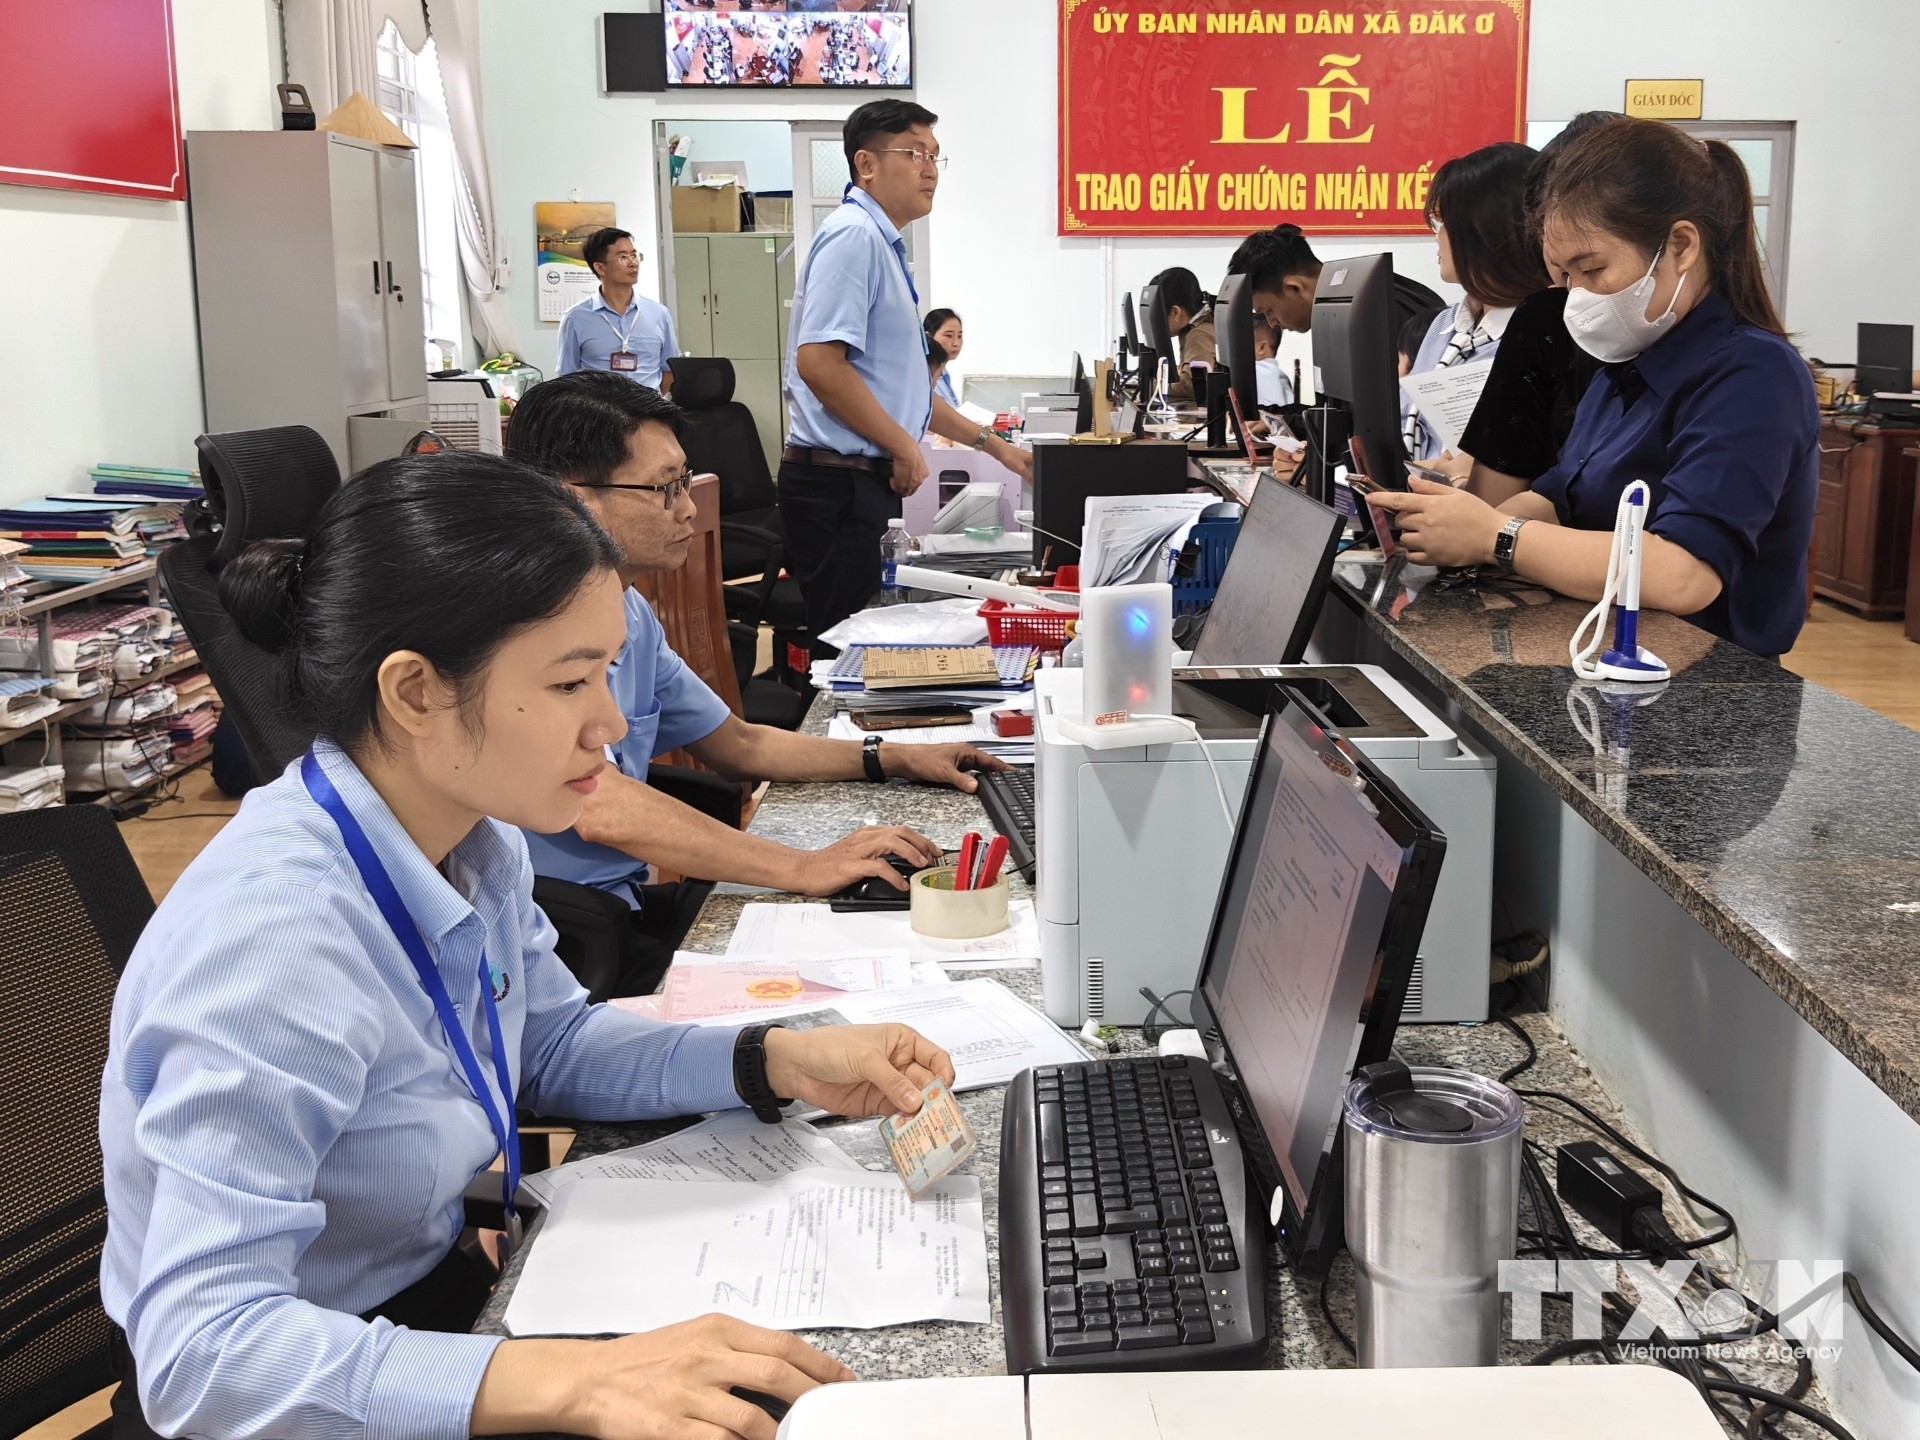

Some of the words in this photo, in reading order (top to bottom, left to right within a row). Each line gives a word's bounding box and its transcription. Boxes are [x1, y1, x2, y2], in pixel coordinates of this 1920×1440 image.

[1094, 7, 1128, 34] ỦY
[1138, 14, 1197, 34] BAN
[1206, 10, 1286, 34] NHÂN
[1296, 10, 1354, 34] DÂN
[1362, 10, 1402, 34] XÃ
[1408, 10, 1467, 35] ĐĂK
[1474, 12, 1496, 35] Ơ
[1210, 54, 1375, 144] LỄ
[1633, 92, 1666, 106] GIÁM
[1076, 173, 1141, 211] TRAO
[1150, 160, 1209, 211] GIẤY
[1218, 165, 1307, 211] CHỨNG
[1315, 165, 1389, 219] NHẬN
[1396, 160, 1436, 210] KẾ
